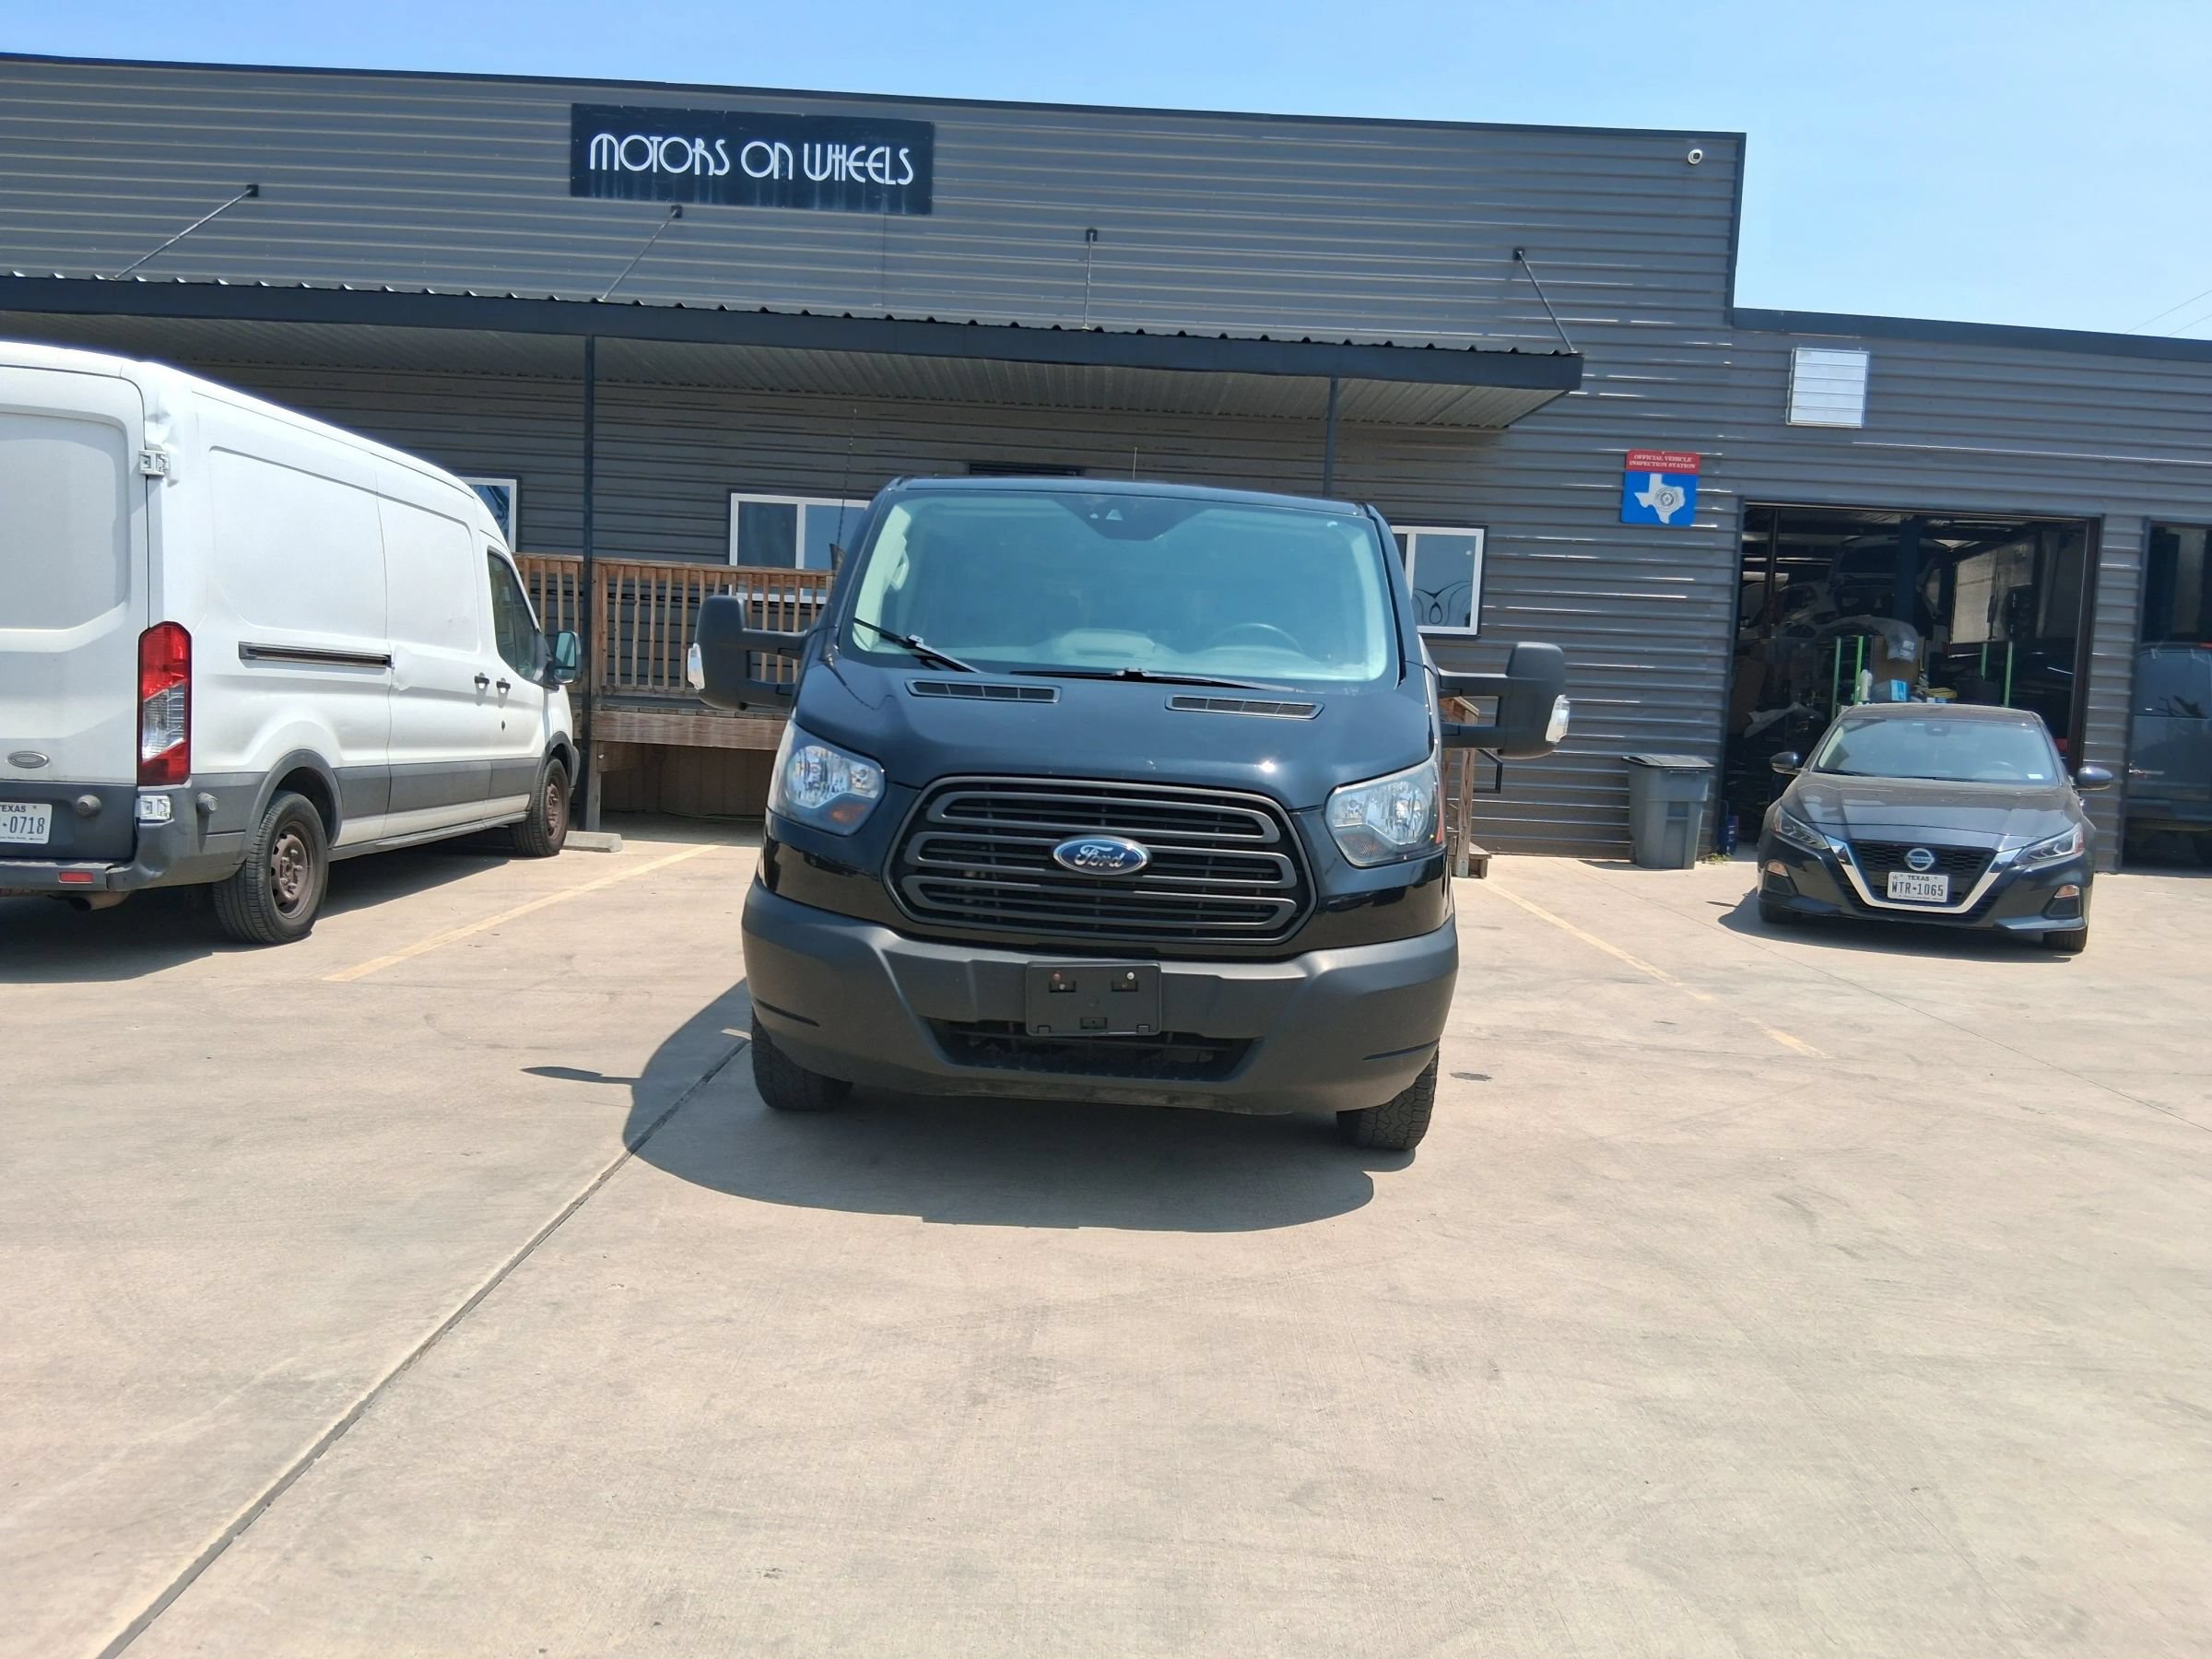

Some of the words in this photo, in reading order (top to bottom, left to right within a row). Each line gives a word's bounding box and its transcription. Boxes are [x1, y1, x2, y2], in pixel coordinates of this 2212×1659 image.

[590, 133, 730, 176] MOTORS
[740, 141, 794, 180] ON
[803, 143, 914, 185] WHEELS
[1633, 453, 1664, 462] OFFICIAL
[1629, 460, 1667, 468] INSPECTION
[0, 805, 26, 813] EXAS
[1075, 844, 1125, 867] Ford
